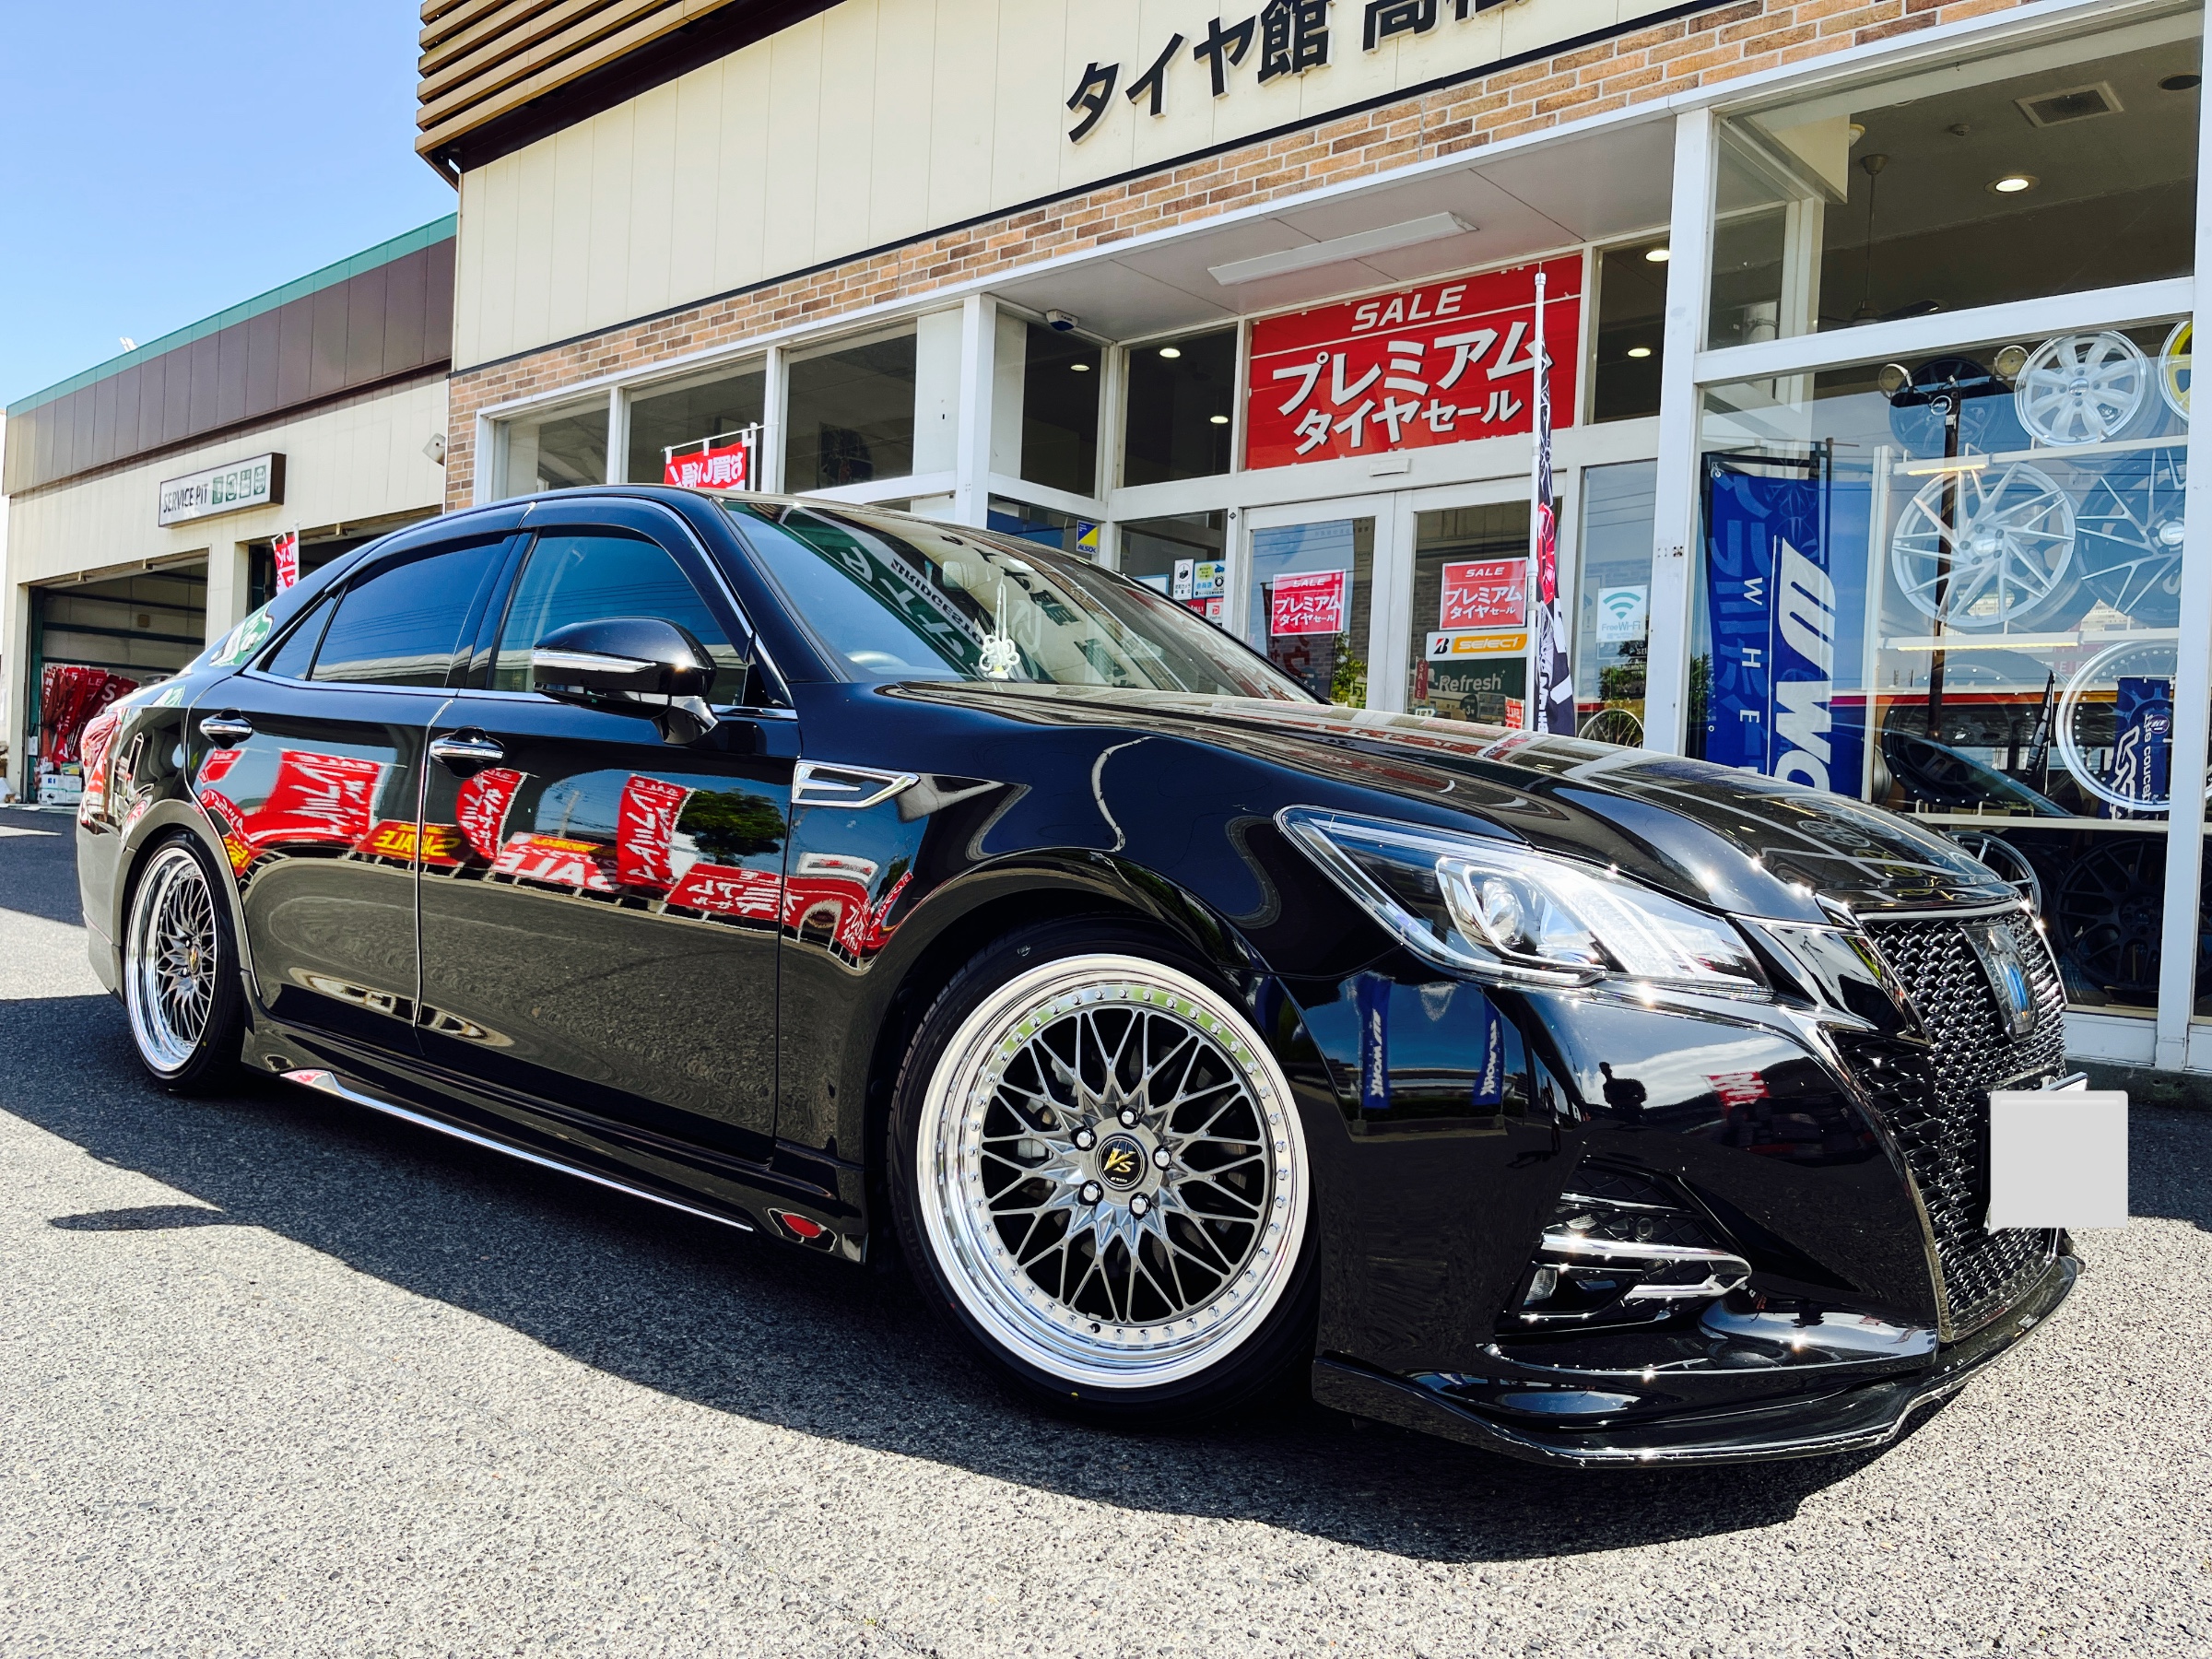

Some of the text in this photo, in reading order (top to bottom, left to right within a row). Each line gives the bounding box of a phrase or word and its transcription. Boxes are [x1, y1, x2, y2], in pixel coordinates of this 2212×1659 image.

[1066, 0, 1334, 144] タイヤ館
[1351, 285, 1468, 333] SALE
[1272, 322, 1554, 417] プレミアム
[1293, 389, 1523, 455] タイヤセール
[163, 488, 194, 513] SERVICE
[195, 483, 209, 506] PIT
[1077, 544, 1097, 554] ALSOK
[1465, 567, 1505, 578] SALE
[1292, 578, 1326, 588] SALE
[1275, 595, 1341, 615] プレミアム
[1445, 585, 1524, 606] プレミアム
[1279, 613, 1335, 627] タイヤセール
[1450, 605, 1516, 619] タイヤセール
[1440, 673, 1501, 692] Refresh
